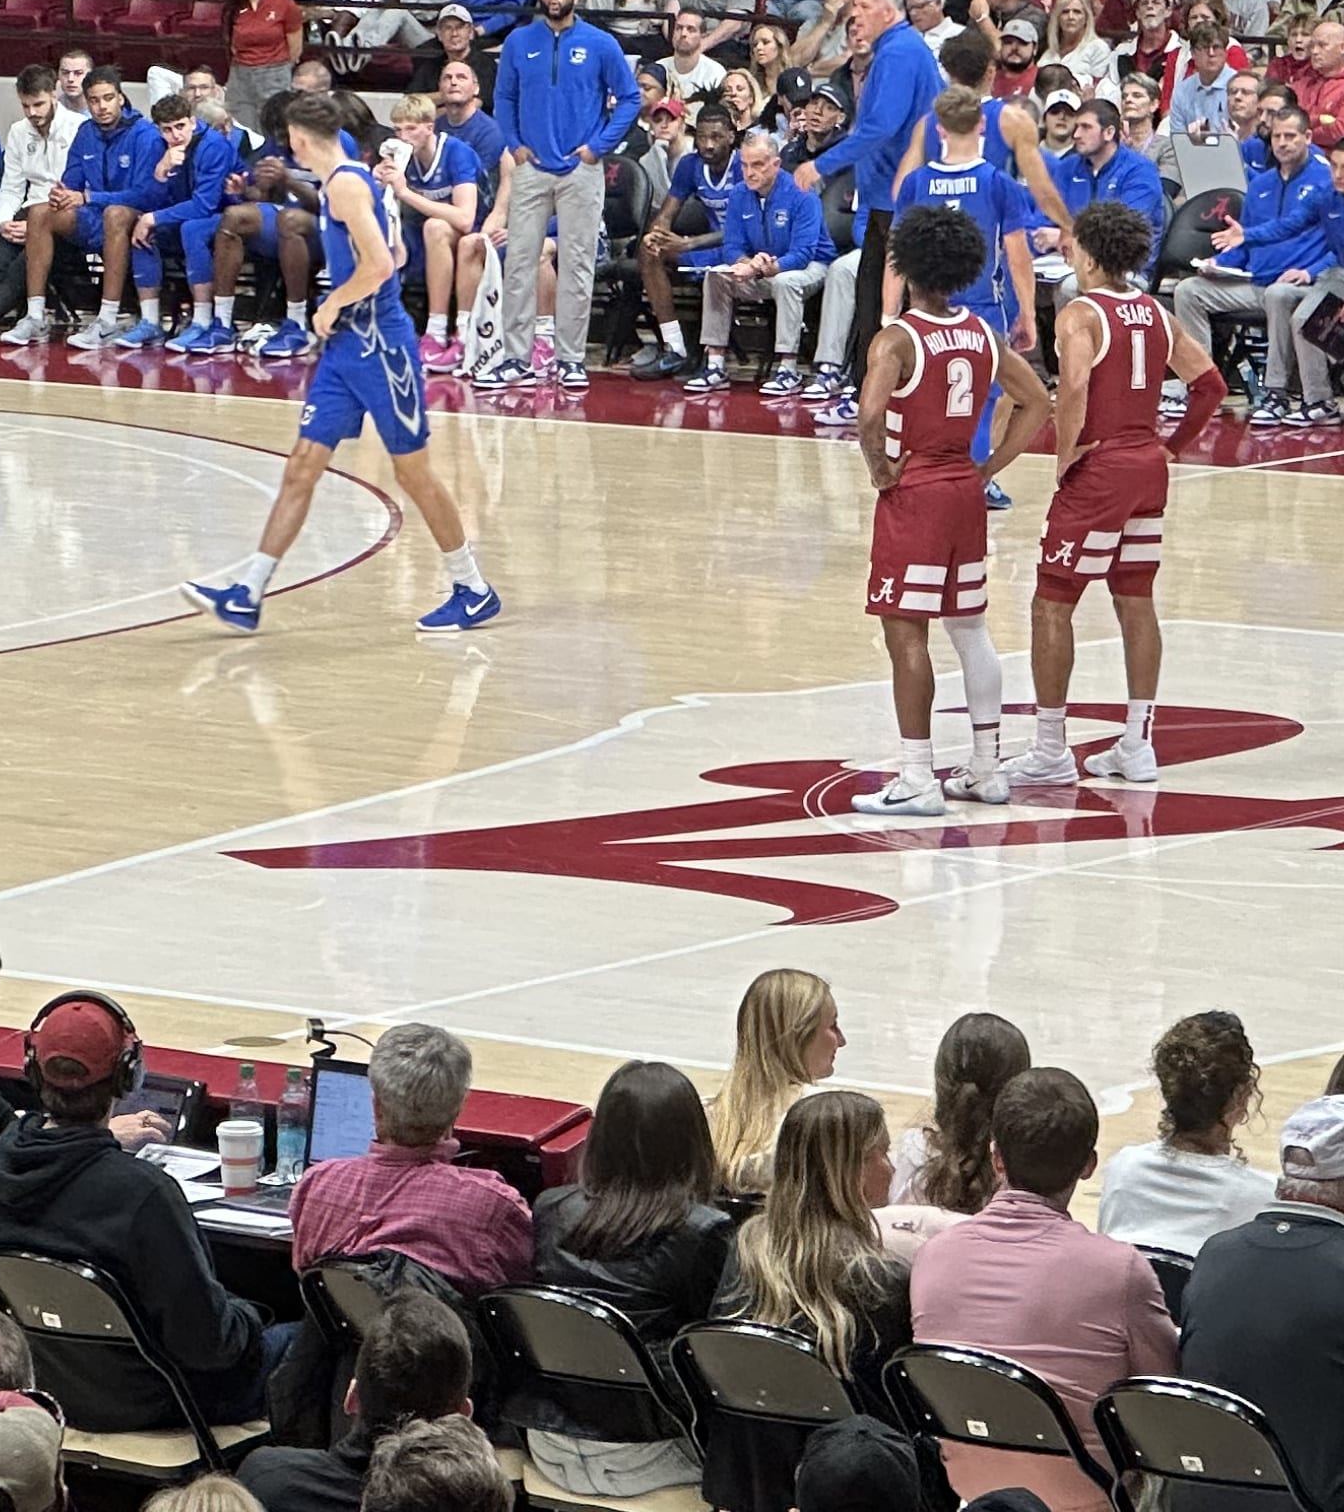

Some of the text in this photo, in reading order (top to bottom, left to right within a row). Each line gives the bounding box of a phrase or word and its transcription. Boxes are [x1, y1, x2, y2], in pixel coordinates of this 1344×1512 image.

[928, 176, 977, 196] ASHWORTH
[1115, 303, 1154, 327] SEARS
[923, 327, 986, 356] HOLLOWAY
[1130, 329, 1146, 390] 1
[946, 356, 973, 418] 2
